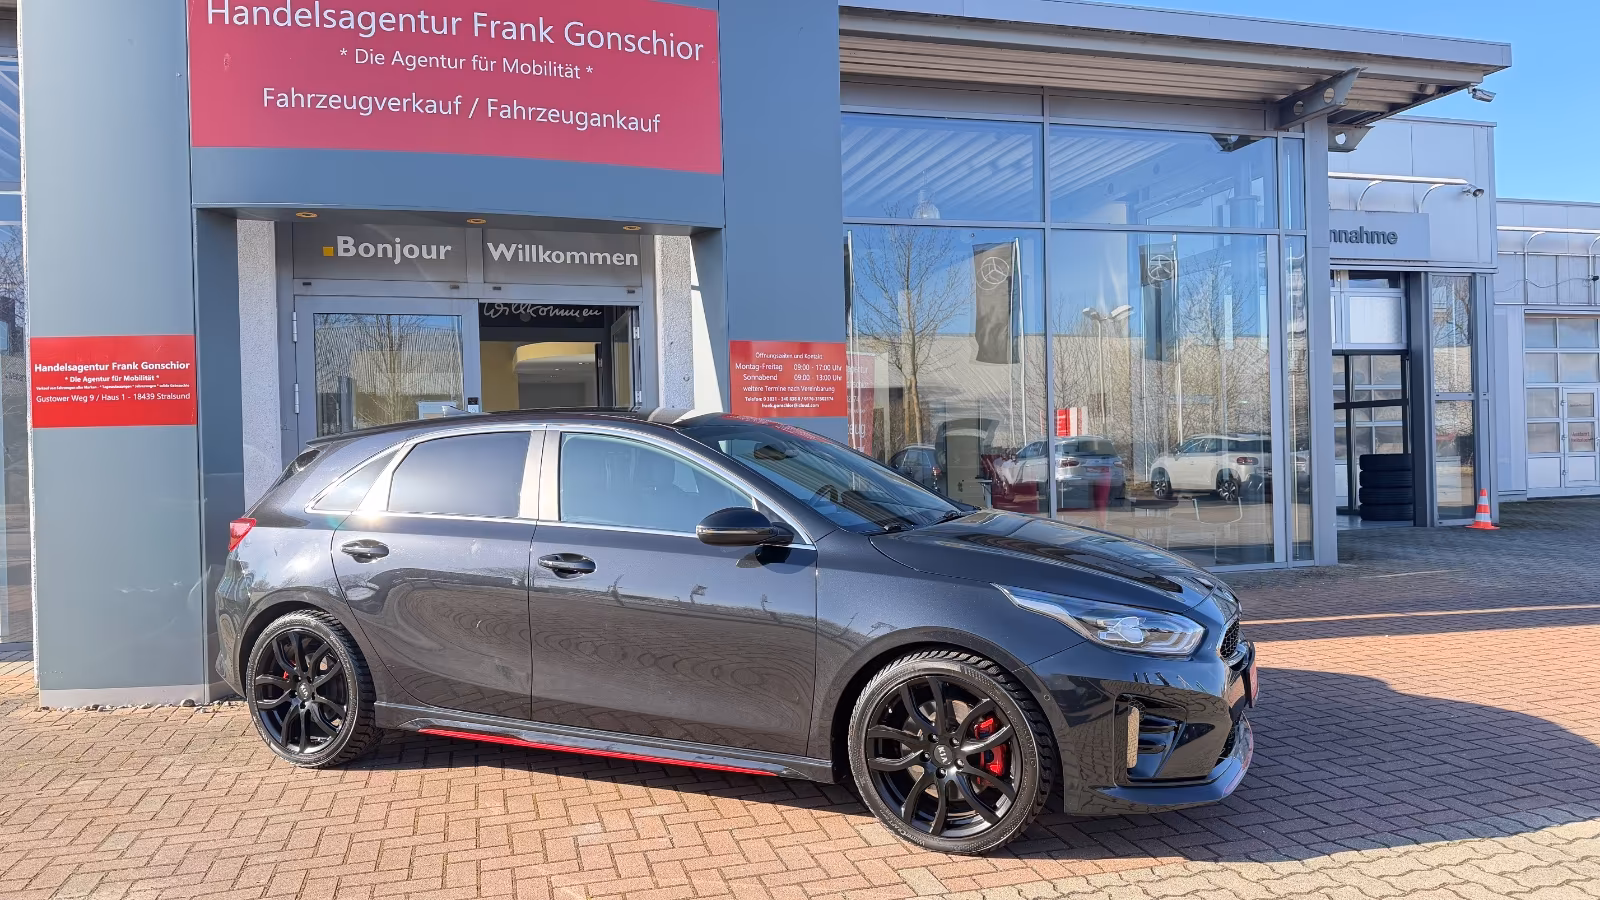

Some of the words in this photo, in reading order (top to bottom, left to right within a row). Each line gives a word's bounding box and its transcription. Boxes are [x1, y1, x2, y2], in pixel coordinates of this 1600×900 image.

[207, 0, 462, 38] Handelsagentur
[473, 12, 555, 44] Frank
[564, 21, 704, 61] Gonschior
[355, 48, 385, 65] Die
[391, 50, 466, 71] Agentur
[472, 54, 497, 72] für
[502, 57, 581, 79] Mobilität
[263, 87, 463, 116] Fahrzeugverkauf
[468, 97, 479, 119] /
[487, 98, 661, 133] Fahrzeugankauf
[336, 235, 452, 265] Bonjour
[487, 242, 639, 266] Willkommen
[34, 362, 110, 374] Handelsagentur
[111, 361, 139, 371] Frank
[140, 360, 191, 370] Gonschior
[735, 362, 783, 372] Montag-Freitag
[793, 363, 810, 371] 09:00
[83, 376, 111, 384] Agentur
[112, 374, 122, 382] für
[742, 373, 778, 381] Sonnabend
[793, 373, 811, 381] 09:00
[815, 374, 831, 382] 13:00
[832, 374, 843, 382] Uhr
[800, 385, 836, 394] Vereinbarung
[36, 395, 70, 403] Gustower
[71, 394, 88, 403] Weg
[102, 393, 120, 401] Haus
[156, 392, 191, 400] Stralsund
[936, 745, 949, 764] KIA
